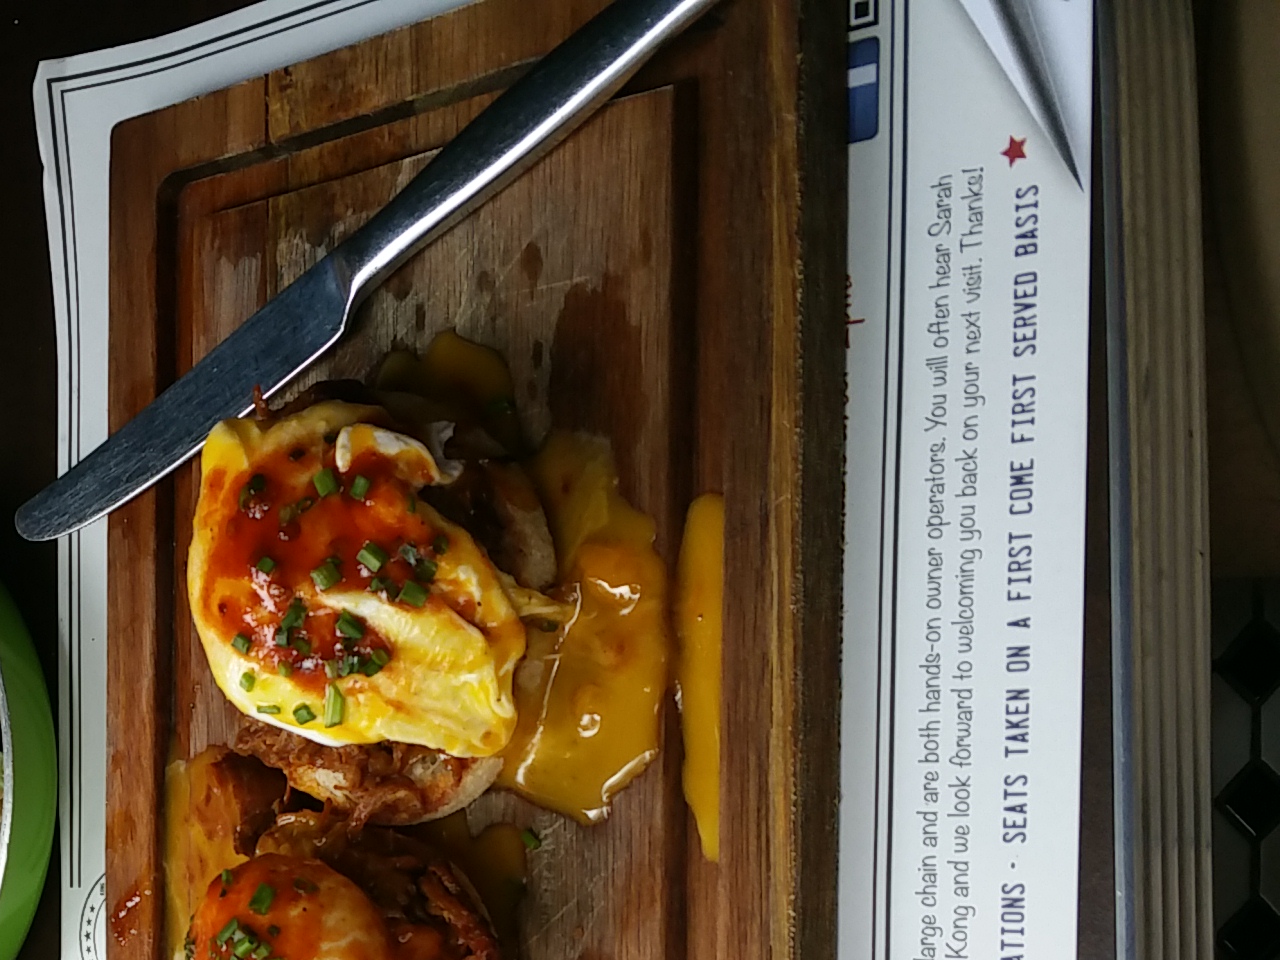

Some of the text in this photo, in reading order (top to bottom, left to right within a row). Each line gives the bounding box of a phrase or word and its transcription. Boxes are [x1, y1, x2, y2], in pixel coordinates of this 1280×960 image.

[927, 175, 953, 236] Sarah
[959, 167, 985, 253] Thanks!
[1013, 185, 1040, 257] BASIS
[928, 244, 952, 289] hear
[961, 258, 983, 303] visit.
[926, 295, 951, 348] often
[960, 312, 982, 354] next
[1012, 271, 1038, 357] SERVED
[925, 356, 949, 387] will
[962, 362, 986, 407] your
[923, 394, 948, 432] You
[961, 415, 979, 440] on
[1010, 374, 1037, 444] FIRST
[924, 437, 952, 539] operators.
[954, 448, 979, 497] back
[1008, 458, 1035, 515] COME
[959, 505, 983, 541] you
[925, 548, 944, 609] owner
[1006, 532, 1033, 601] FIRST
[950, 549, 983, 653] welcoming
[1006, 617, 1032, 629] A
[918, 618, 942, 712] hands-on
[951, 661, 973, 680] to
[1005, 645, 1031, 672] ON
[917, 721, 941, 763] both
[948, 689, 974, 768] forward
[1004, 689, 1031, 758] TAKEN
[923, 771, 940, 803] are
[946, 776, 972, 817] look
[1001, 775, 1029, 843] SEATS
[915, 811, 939, 847] and
[953, 825, 971, 853] we
[914, 856, 938, 907] chain
[946, 861, 970, 897] and
[944, 906, 977, 959] Kong
